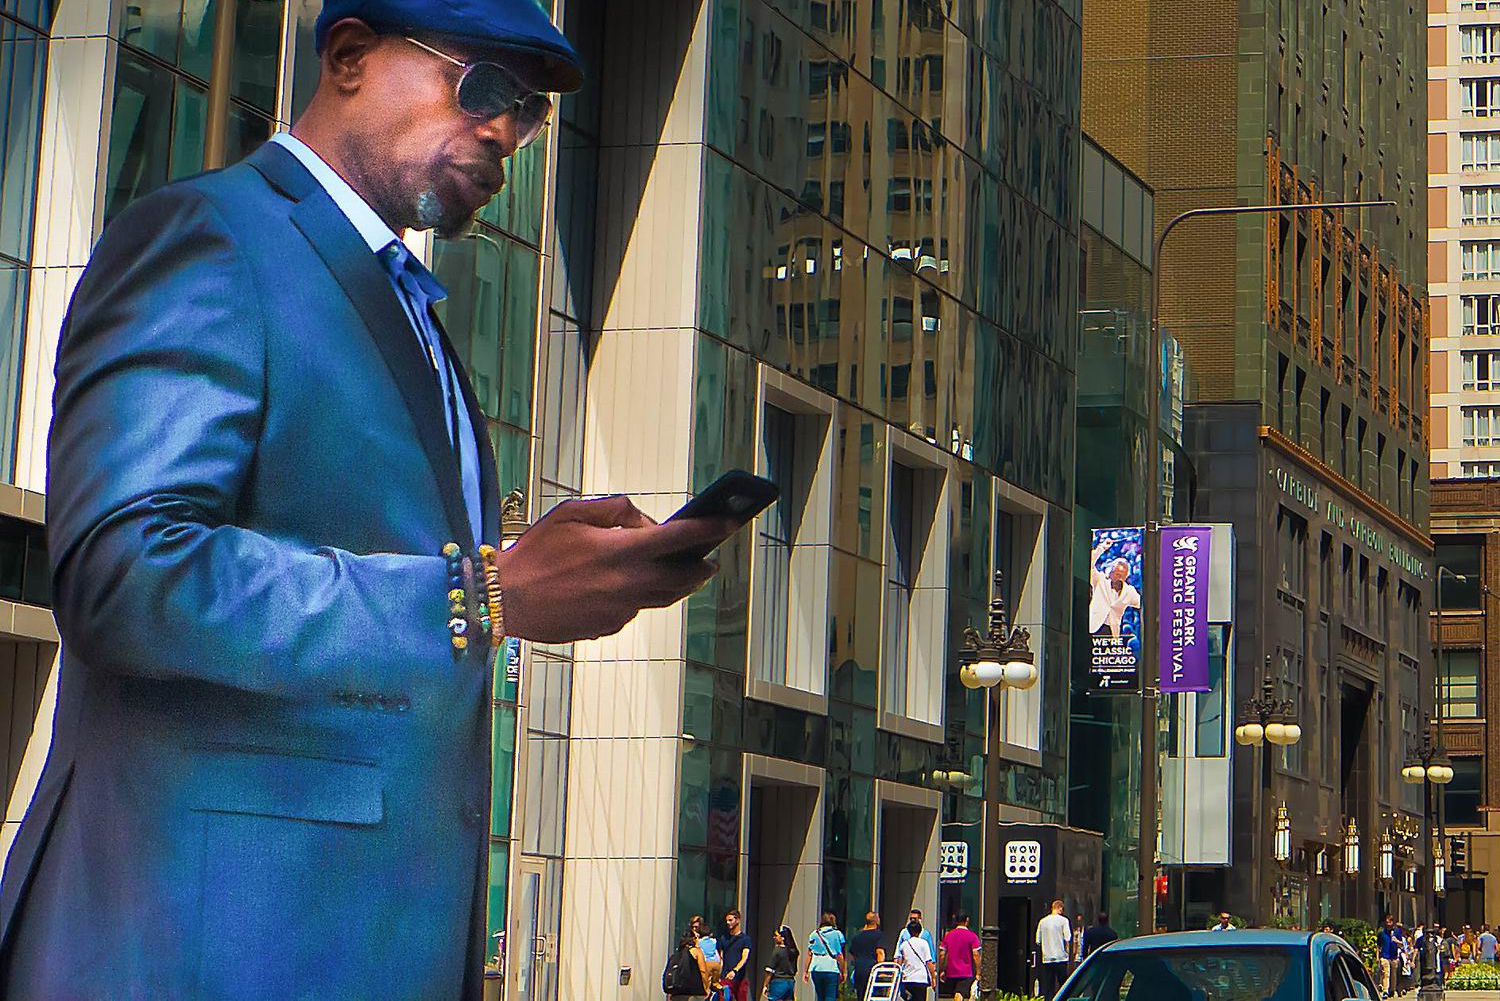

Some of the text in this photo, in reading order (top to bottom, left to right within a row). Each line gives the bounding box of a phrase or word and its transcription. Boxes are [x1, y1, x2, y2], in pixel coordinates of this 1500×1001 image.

[1184, 555, 1197, 646] GRANT PARK
[1171, 555, 1184, 683] MUSIC FESTIVAL
[1092, 637, 1124, 646] WE'RE
[1092, 646, 1133, 656] CLASSIC
[1092, 656, 1136, 665] CHICAGO
[1009, 845, 1037, 854] WOW
[1009, 855, 1037, 863] BAO
